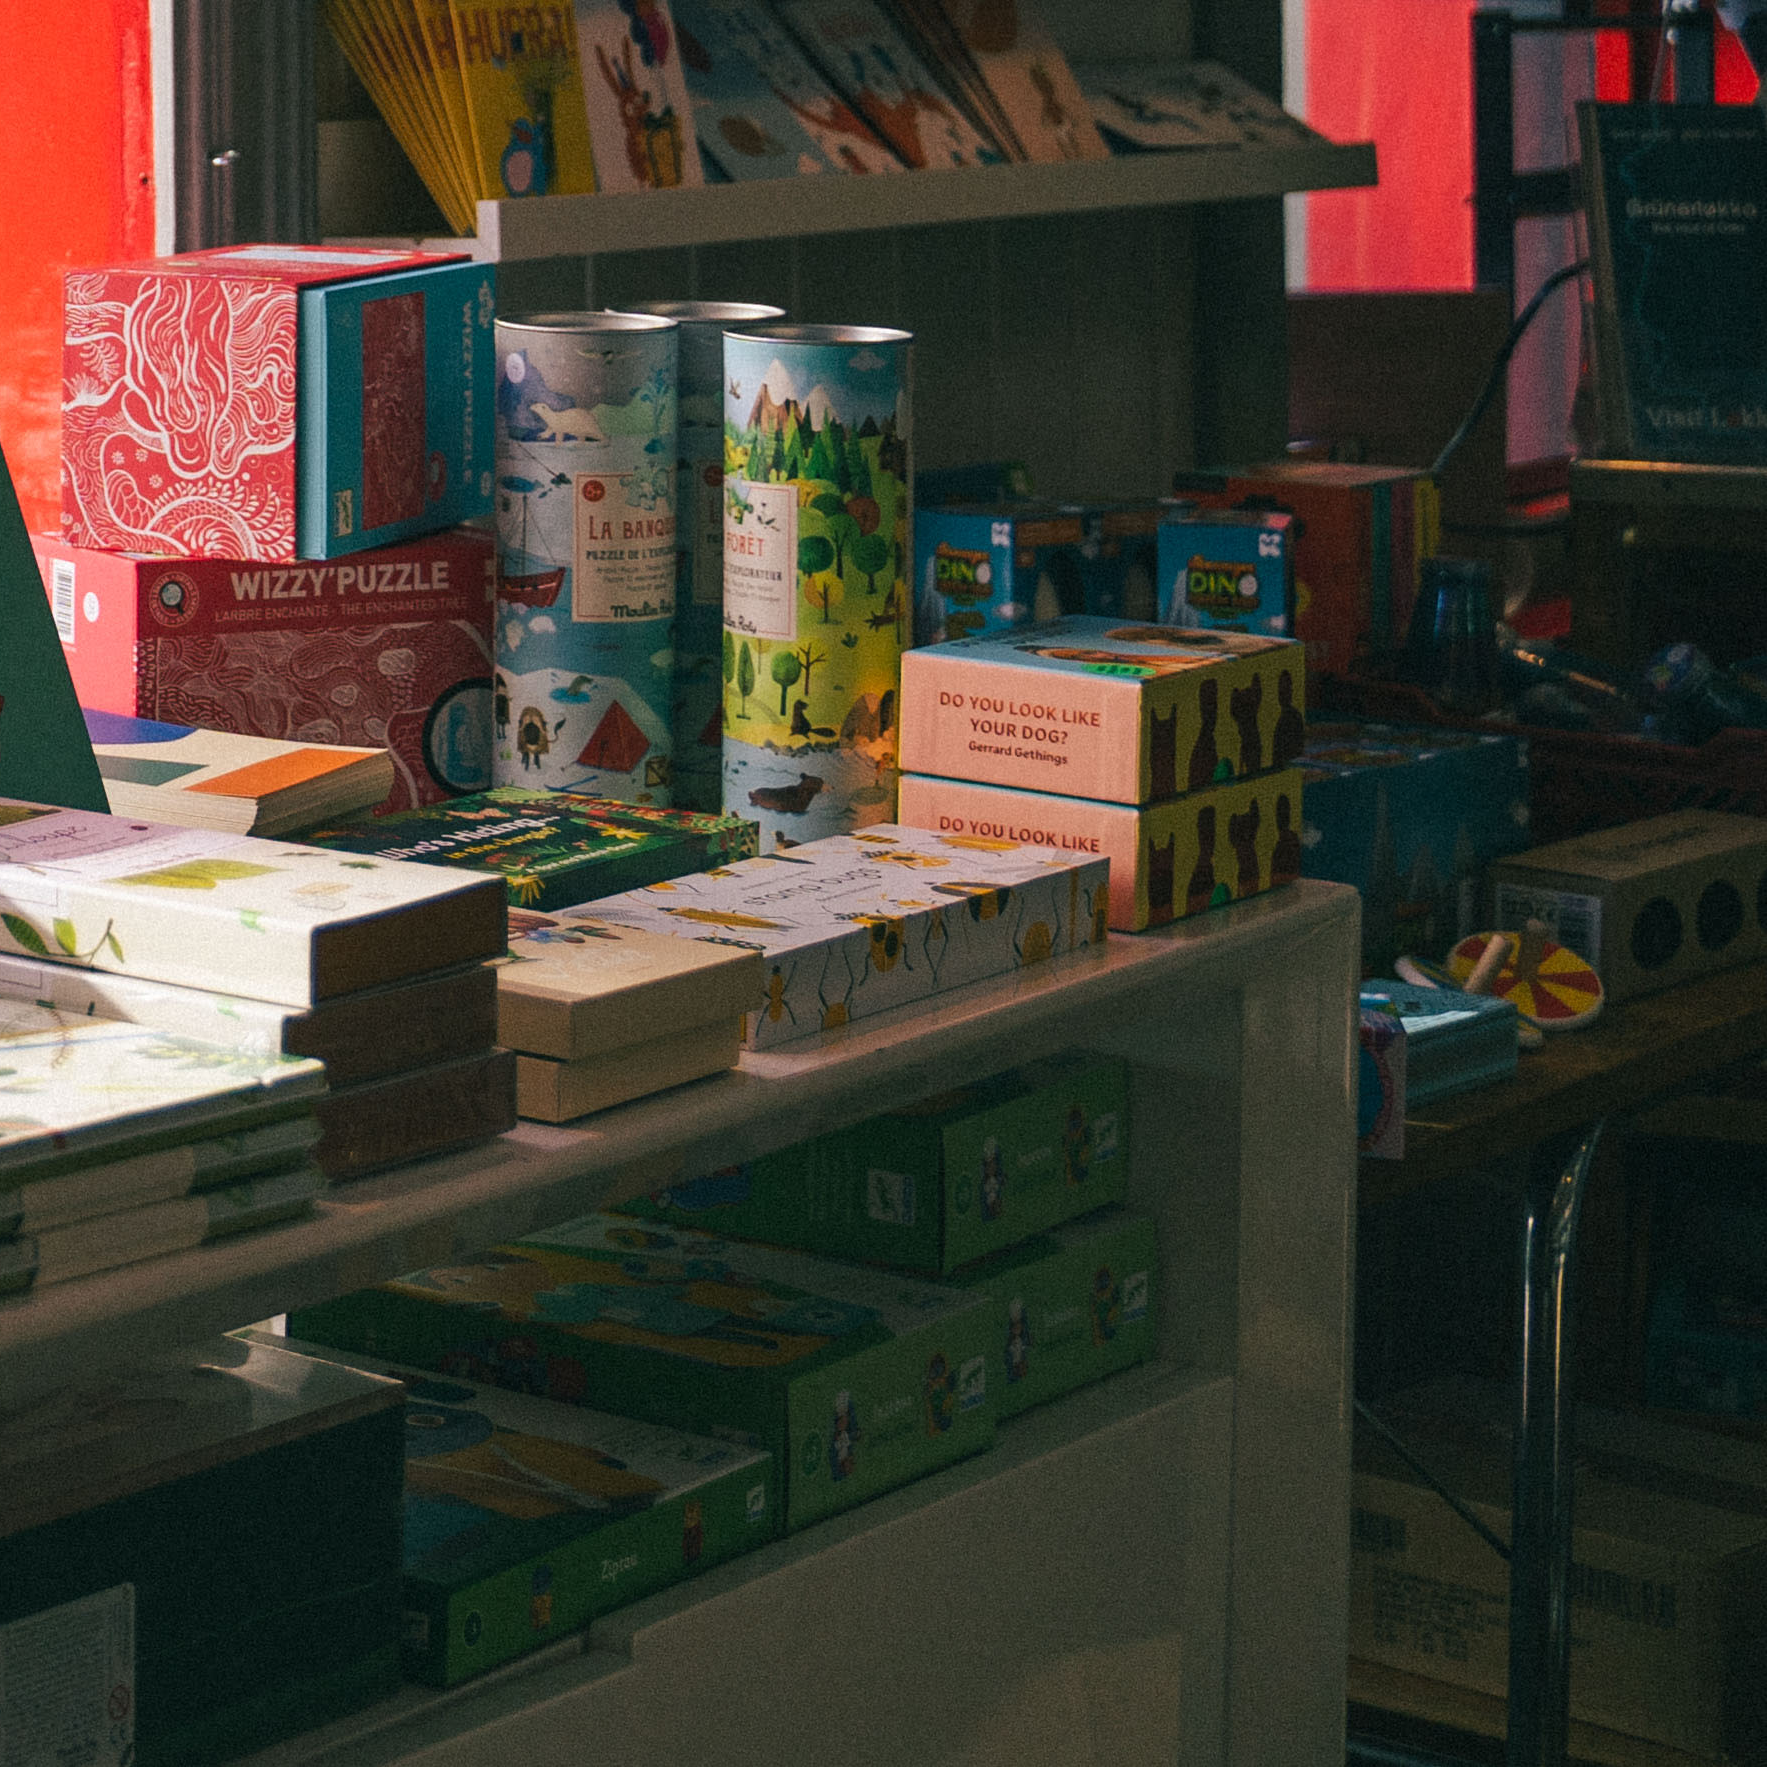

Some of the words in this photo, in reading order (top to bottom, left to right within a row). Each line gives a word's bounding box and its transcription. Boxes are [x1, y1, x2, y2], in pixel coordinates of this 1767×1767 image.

[588, 516, 613, 540] LA
[230, 560, 450, 602] WIZZY'PUZZLE
[340, 600, 363, 616] THE
[364, 597, 439, 616] ENCHANTED
[939, 691, 964, 708] DO
[969, 695, 1004, 714] YOU
[1009, 701, 1057, 721] LOOK
[1062, 709, 1100, 728] LIKE
[970, 718, 1016, 738] YOUR
[1022, 725, 1068, 745] DOG?
[969, 740, 1012, 757] Gerrard
[1014, 747, 1068, 766] Gethings
[939, 816, 964, 832] DO
[969, 820, 1004, 839] YOU
[1009, 826, 1057, 847] LOOK
[1062, 834, 1100, 853] LIKE
[374, 838, 456, 861] Who's
